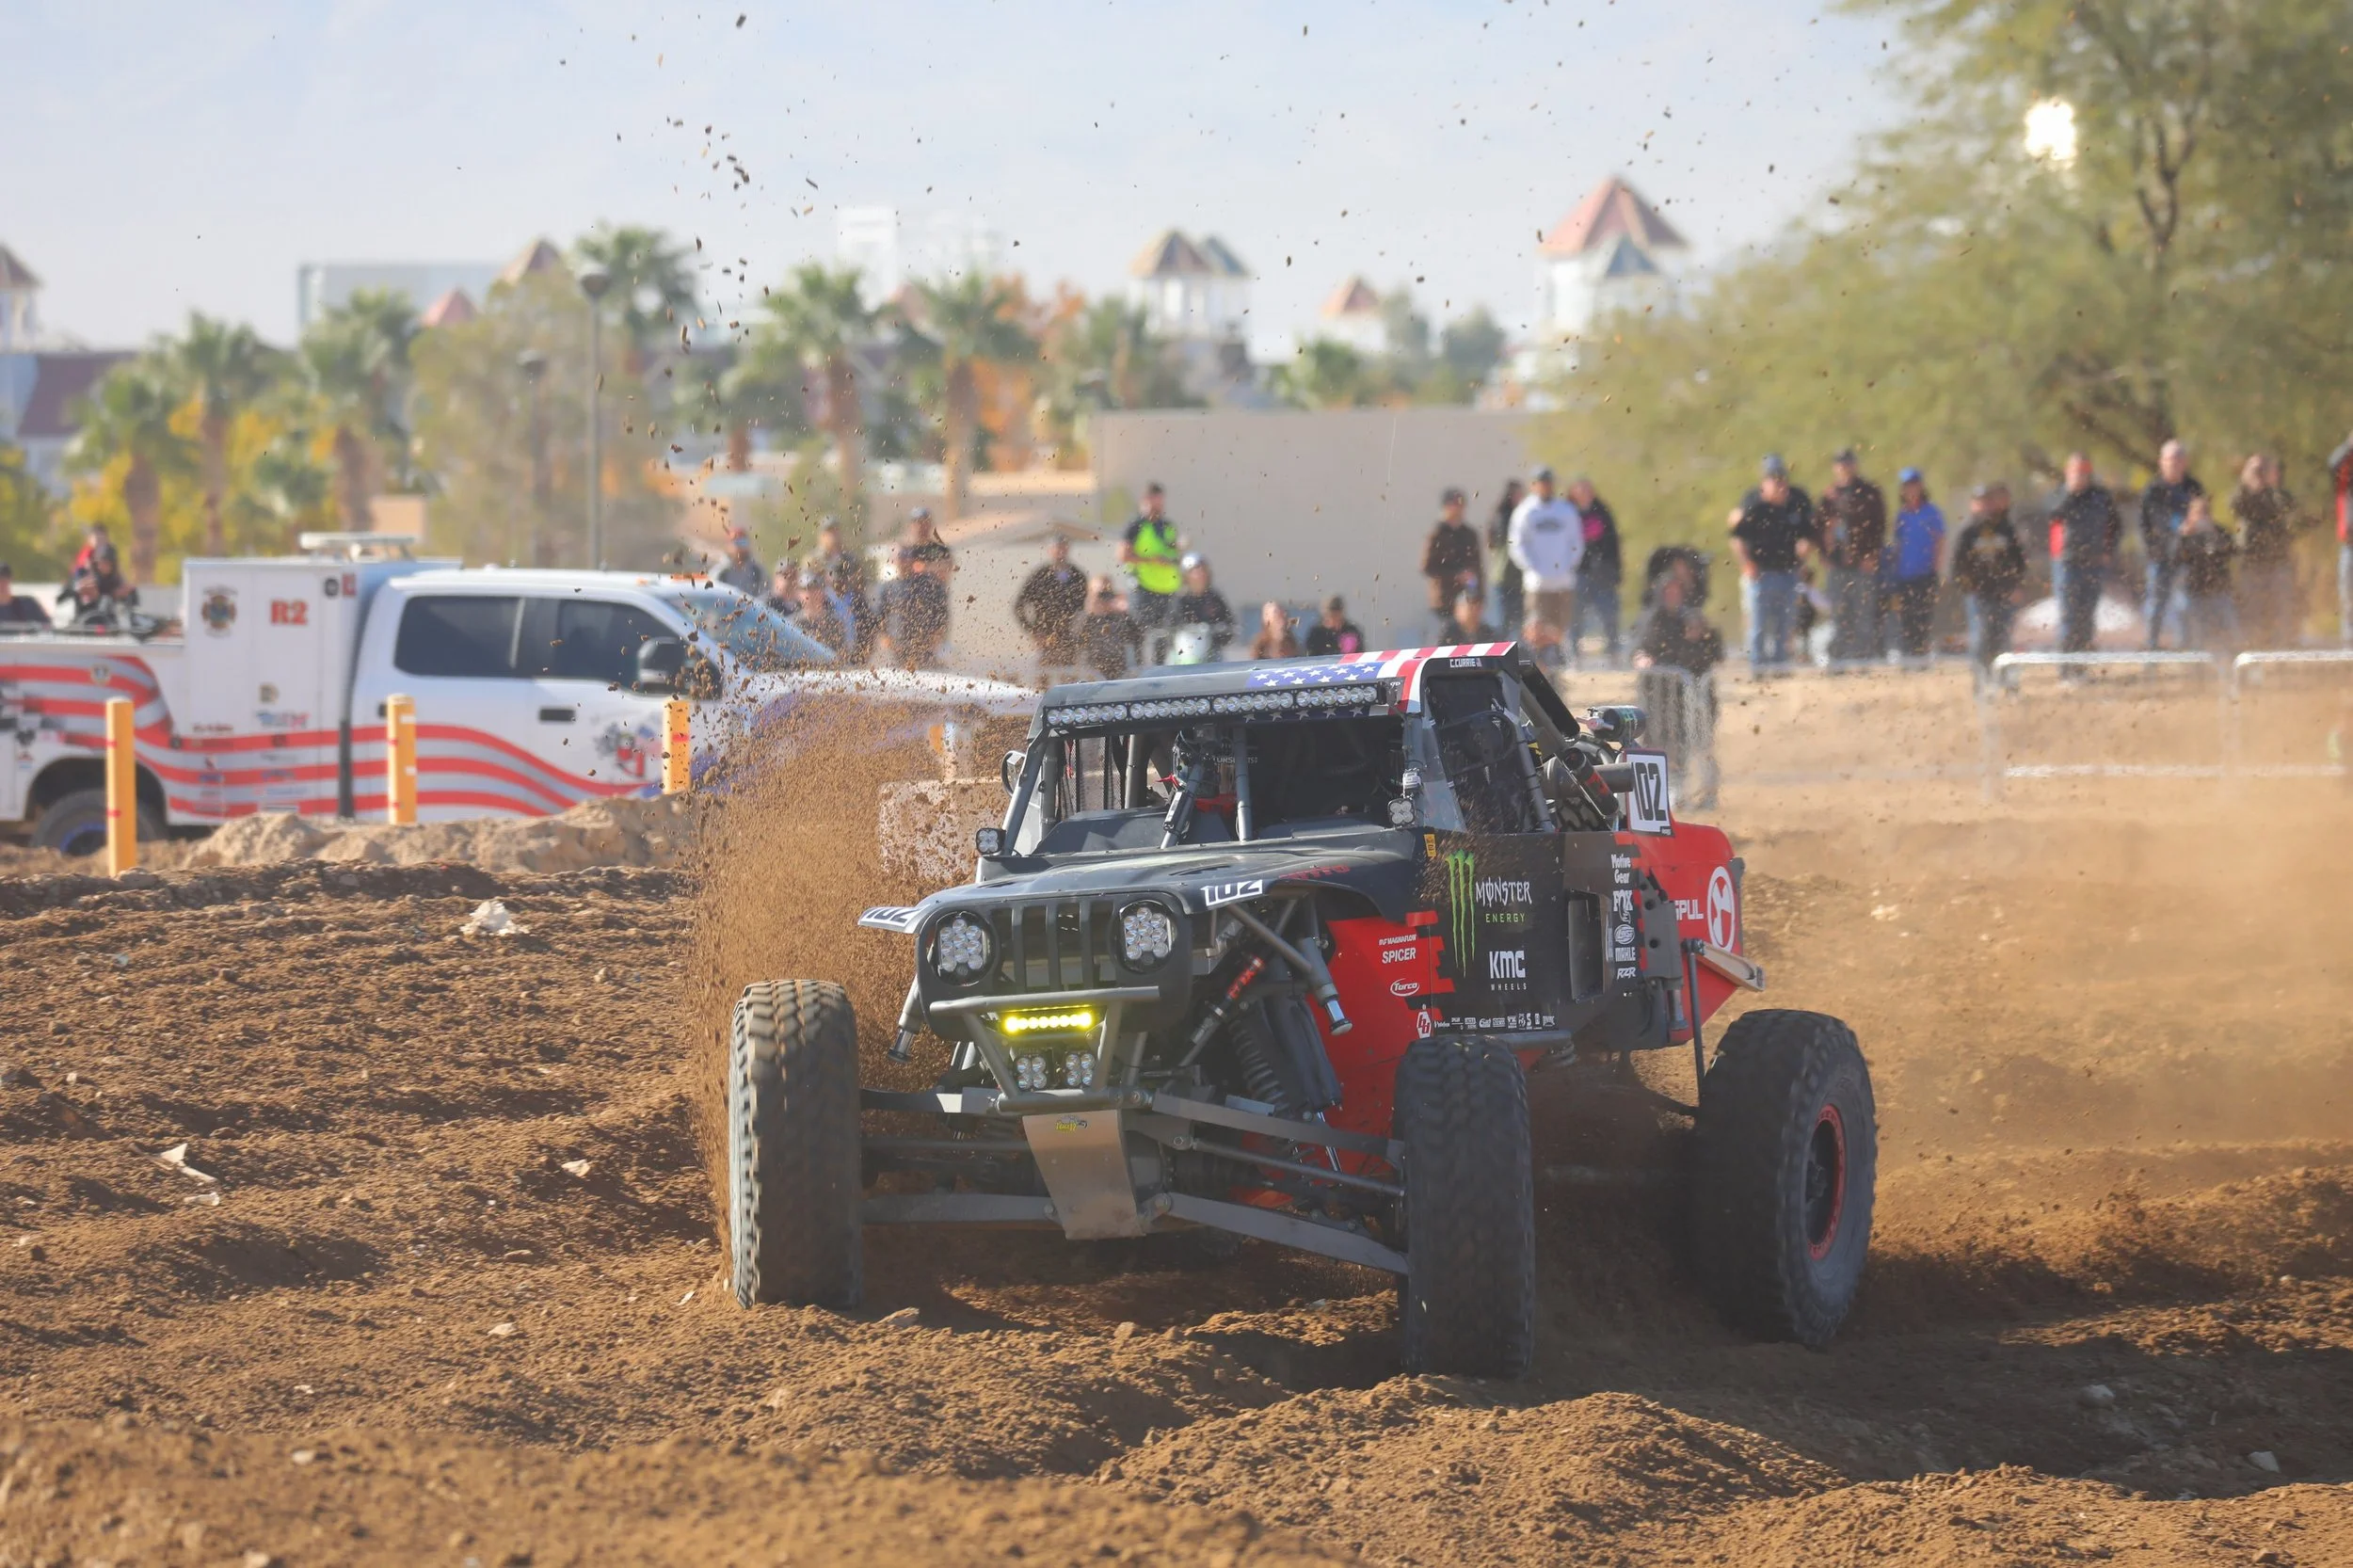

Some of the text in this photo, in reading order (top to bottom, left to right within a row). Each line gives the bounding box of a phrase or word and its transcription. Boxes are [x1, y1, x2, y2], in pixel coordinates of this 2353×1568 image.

[270, 600, 308, 625] R2
[1631, 761, 1667, 821] 102
[1614, 869, 1630, 884] Gear
[1204, 880, 1261, 904] 102
[1613, 889, 1634, 912] FOX
[1485, 913, 1526, 923] ENERGY
[1382, 948, 1417, 964] SPICER
[1615, 947, 1636, 962] MAHLE
[1491, 983, 1528, 991] WHEELS
